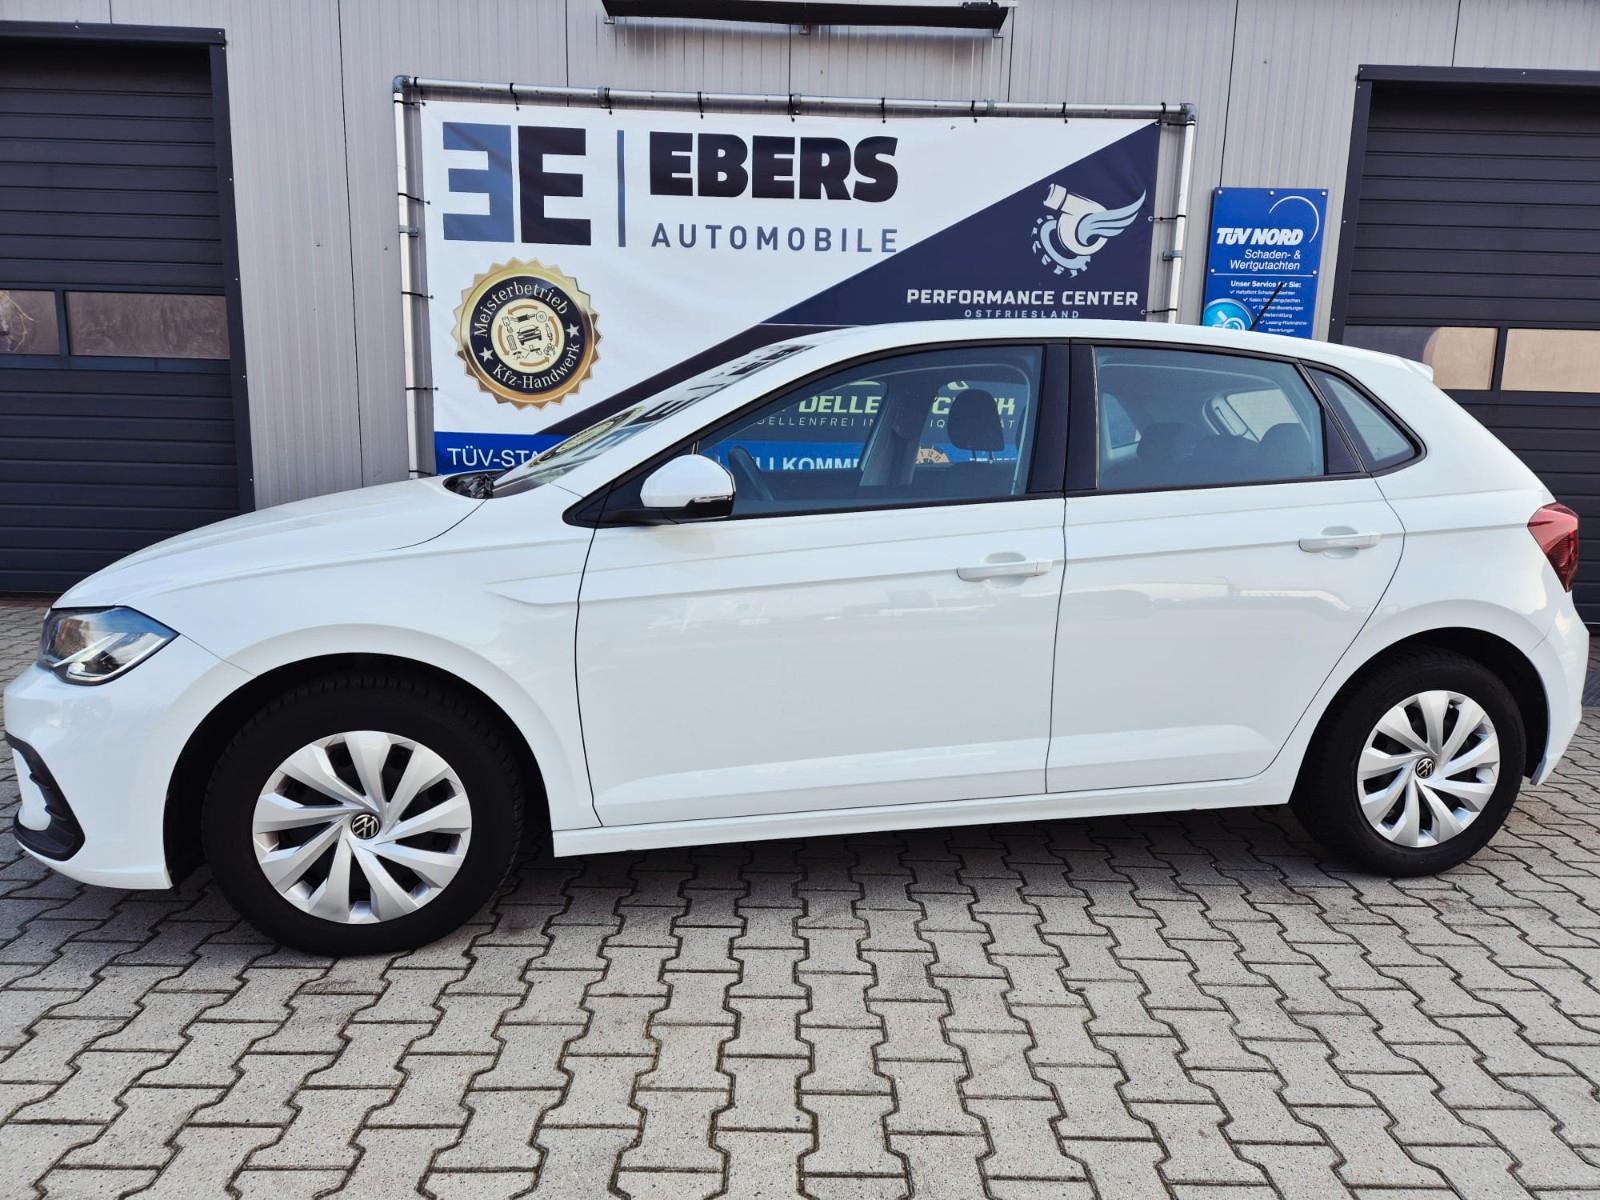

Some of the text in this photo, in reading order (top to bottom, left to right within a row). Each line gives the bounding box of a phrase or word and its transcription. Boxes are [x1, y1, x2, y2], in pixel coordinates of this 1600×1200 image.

[649, 130, 898, 203] EBERS
[651, 222, 898, 253] AUTOMOBILE
[1216, 227, 1304, 246] TÜV NORD
[1244, 248, 1301, 260] Schaden- &
[1230, 259, 1300, 272] Wertgutachten
[1230, 280, 1250, 288] Unser
[1251, 280, 1277, 288] Service
[906, 289, 1139, 306] PERFORMANCE CENTER
[473, 281, 568, 338] Meisterbetrieb
[964, 309, 1080, 319] OSTFRIESLAND
[492, 342, 581, 389] Kfz-Handwerk
[798, 395, 882, 414] DELLE
